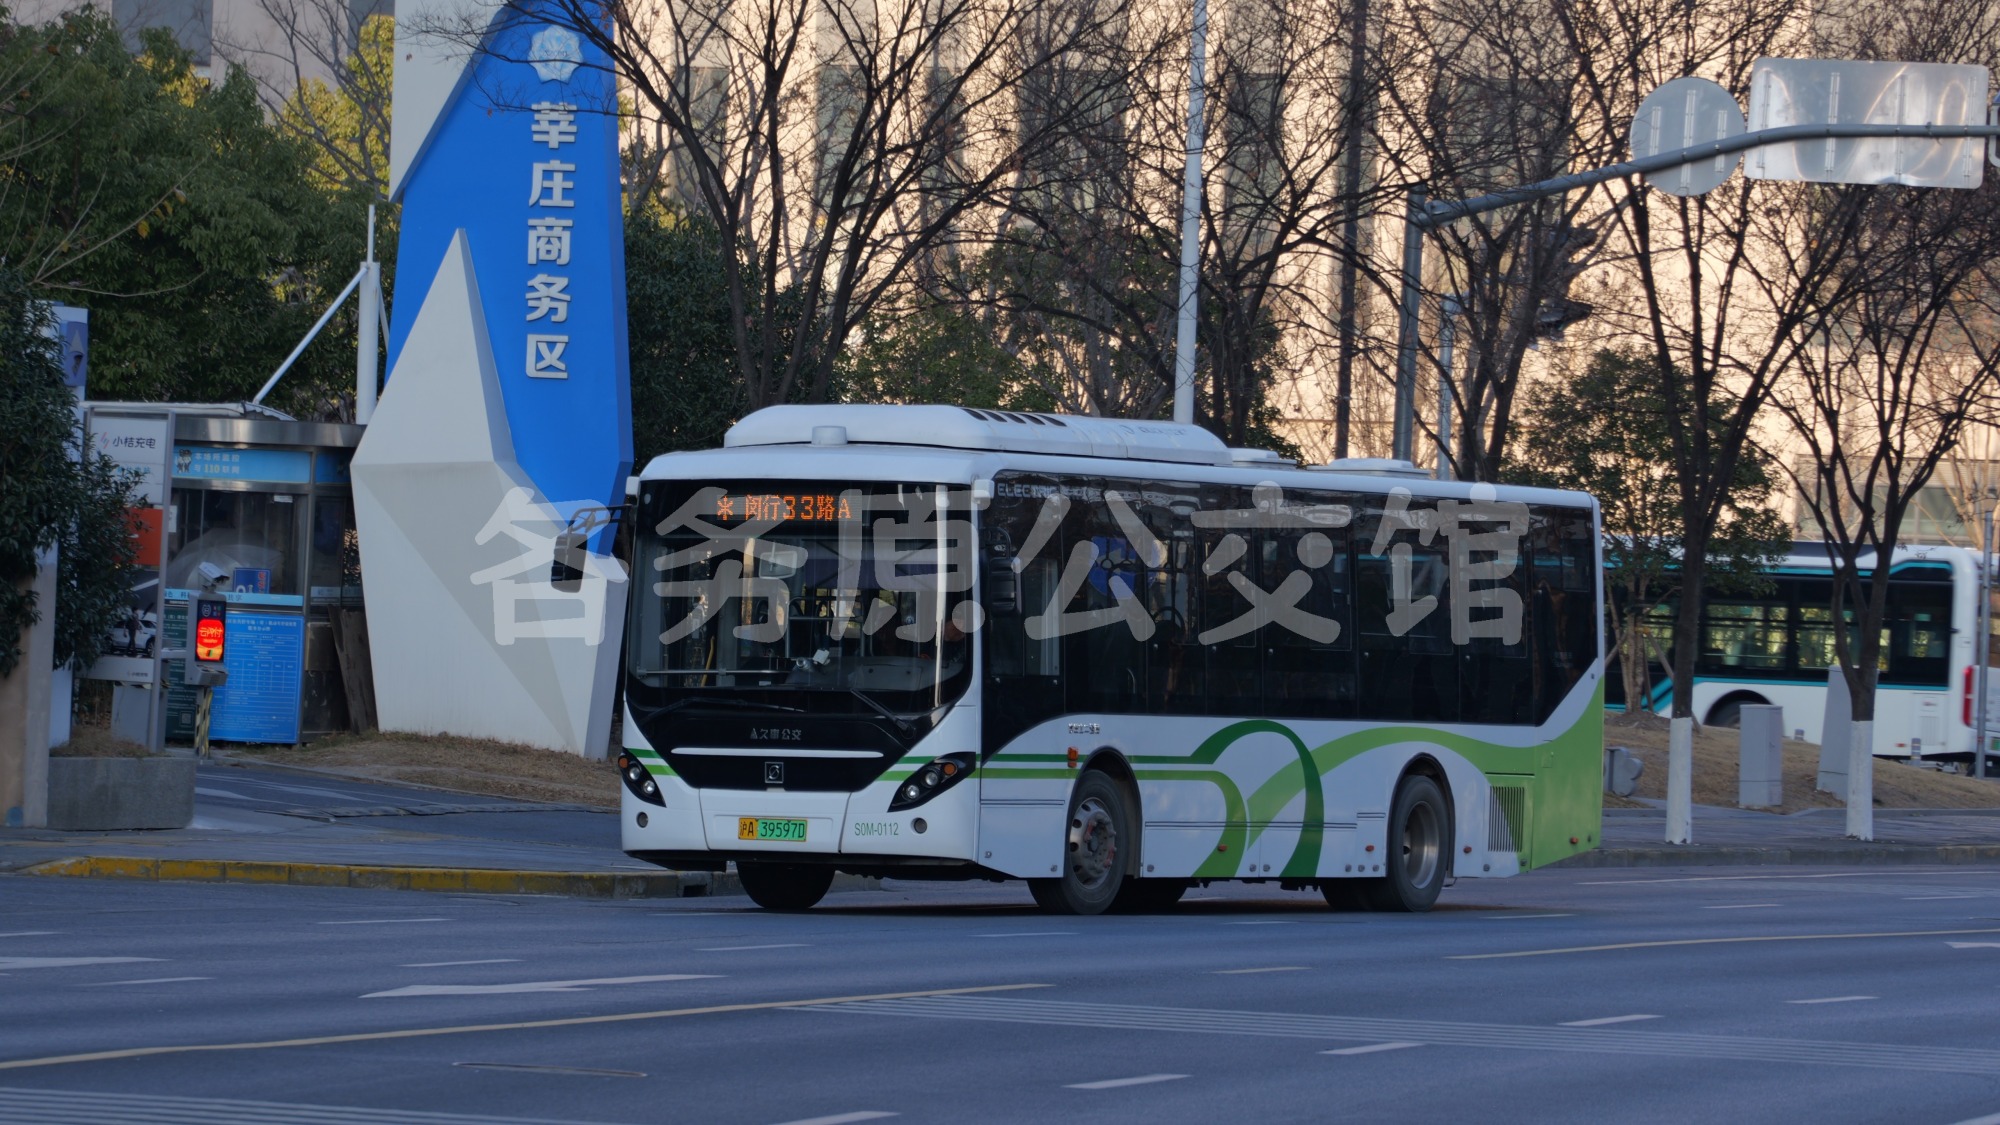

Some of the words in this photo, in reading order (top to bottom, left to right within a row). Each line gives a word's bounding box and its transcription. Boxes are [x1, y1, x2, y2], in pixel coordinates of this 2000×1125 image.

[525, 102, 577, 379] 莘庄商务区
[112, 436, 156, 449] 小桔充电
